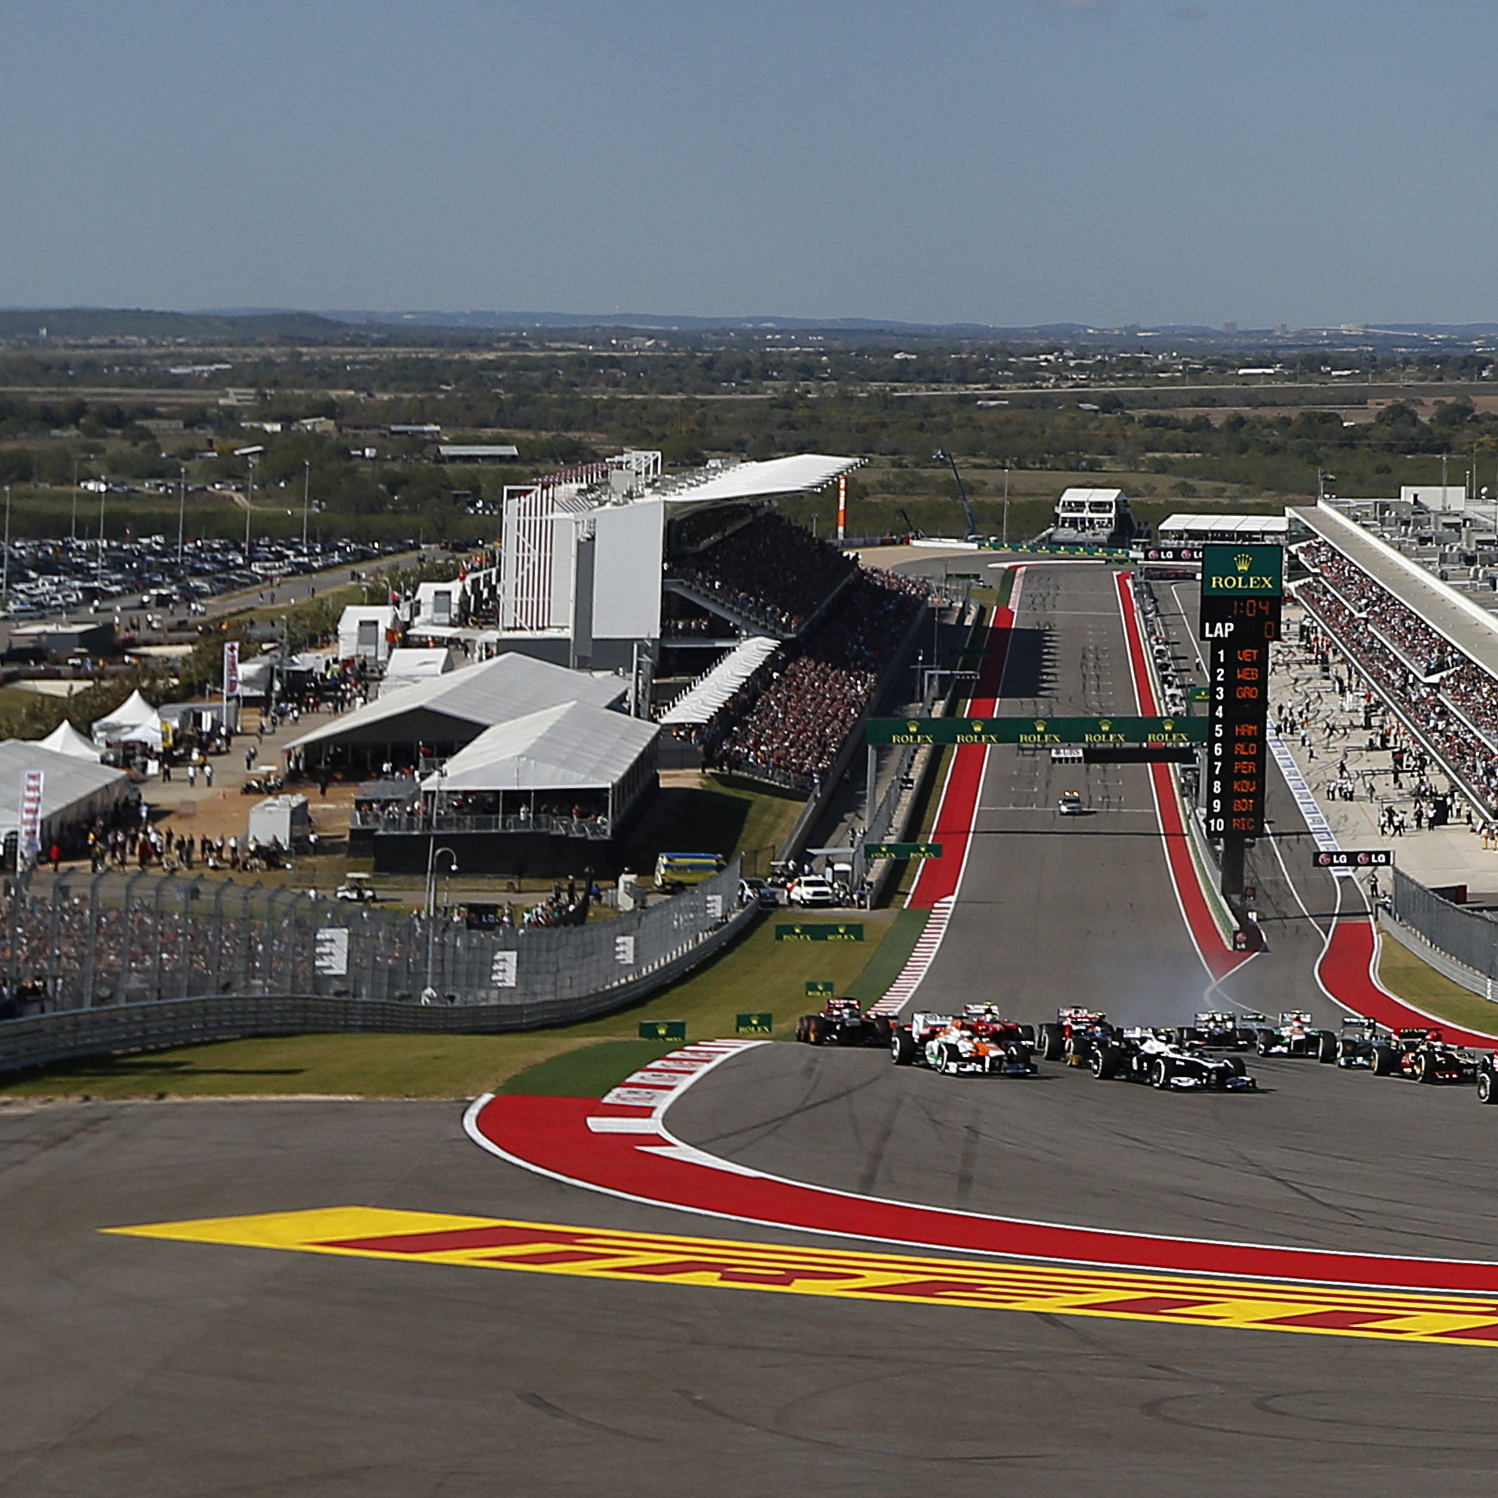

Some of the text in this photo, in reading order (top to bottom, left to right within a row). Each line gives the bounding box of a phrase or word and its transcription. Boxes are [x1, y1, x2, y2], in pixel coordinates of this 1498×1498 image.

[1211, 576, 1273, 589] ROLEX
[1205, 622, 1234, 638] LAP
[1217, 649, 1225, 662] 1
[1216, 668, 1225, 681] 2
[1215, 687, 1224, 700] 3
[1215, 705, 1223, 718] 4
[1214, 724, 1223, 737] 5
[892, 734, 934, 744] ROLEX
[957, 734, 998, 744] ROLEX
[1019, 734, 1061, 744] ROLEX
[1085, 734, 1126, 744] ROLEX
[1147, 733, 1189, 743] ROLEX
[1213, 743, 1222, 756] 6
[1213, 762, 1222, 775] 7
[1213, 781, 1222, 794] 8
[1212, 799, 1221, 813] 9
[1209, 818, 1224, 832] 10
[1333, 854, 1348, 864] LG
[1371, 853, 1386, 863] LG
